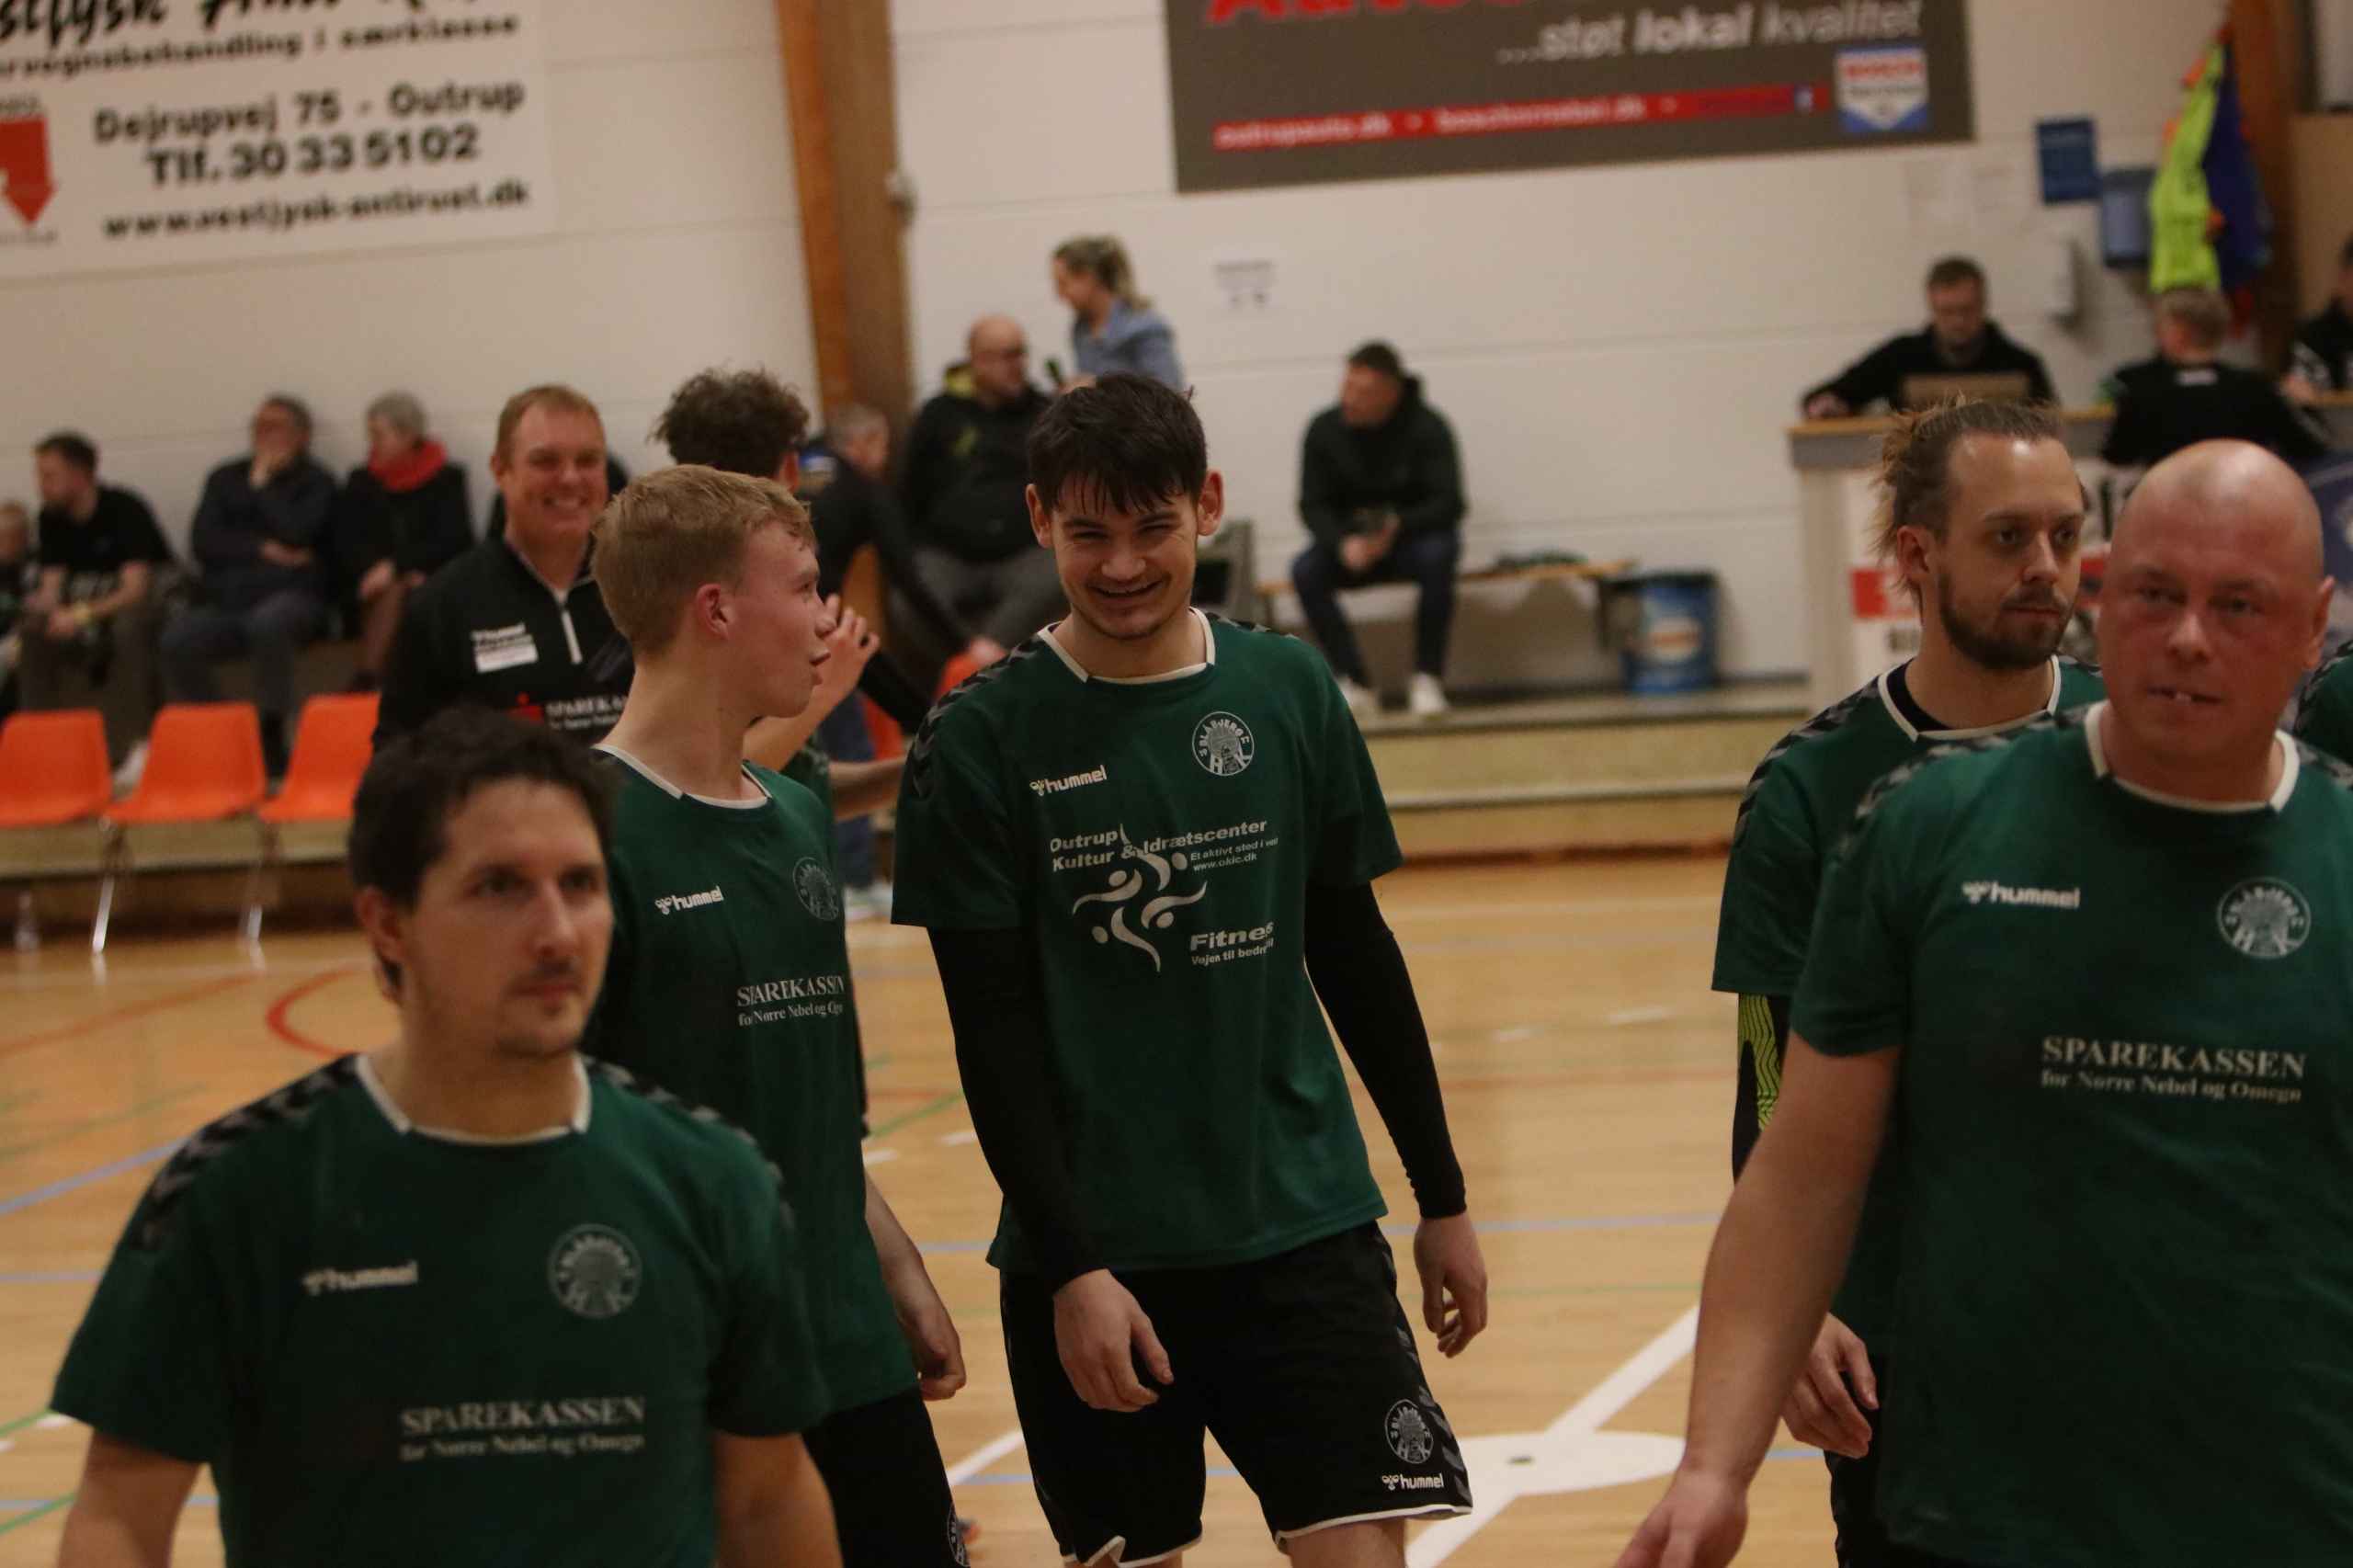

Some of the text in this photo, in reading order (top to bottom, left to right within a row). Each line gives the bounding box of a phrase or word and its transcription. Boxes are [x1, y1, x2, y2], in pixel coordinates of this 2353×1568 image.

[1631, 2, 1755, 53] lokal
[295, 89, 341, 125] 75
[388, 81, 527, 119] Outrup
[1044, 764, 1108, 793] hummel
[1050, 830, 1118, 853] Outrup
[1202, 846, 1233, 858] aktivt
[1234, 840, 1257, 853] sted
[1052, 849, 1114, 872] Kultur
[1120, 843, 1136, 859] &
[671, 885, 724, 911] hummel
[1991, 881, 2081, 908] hummel
[1222, 949, 1235, 961] til
[2042, 1036, 2307, 1079] SPAREKASSEN
[2041, 1069, 2072, 1088] for
[2143, 1074, 2198, 1096] Nebel
[2202, 1082, 2225, 1101] og
[2231, 1080, 2302, 1103] Omegn
[399, 1396, 644, 1435] SPAREKASSEN
[1400, 1472, 1445, 1490] hummel
